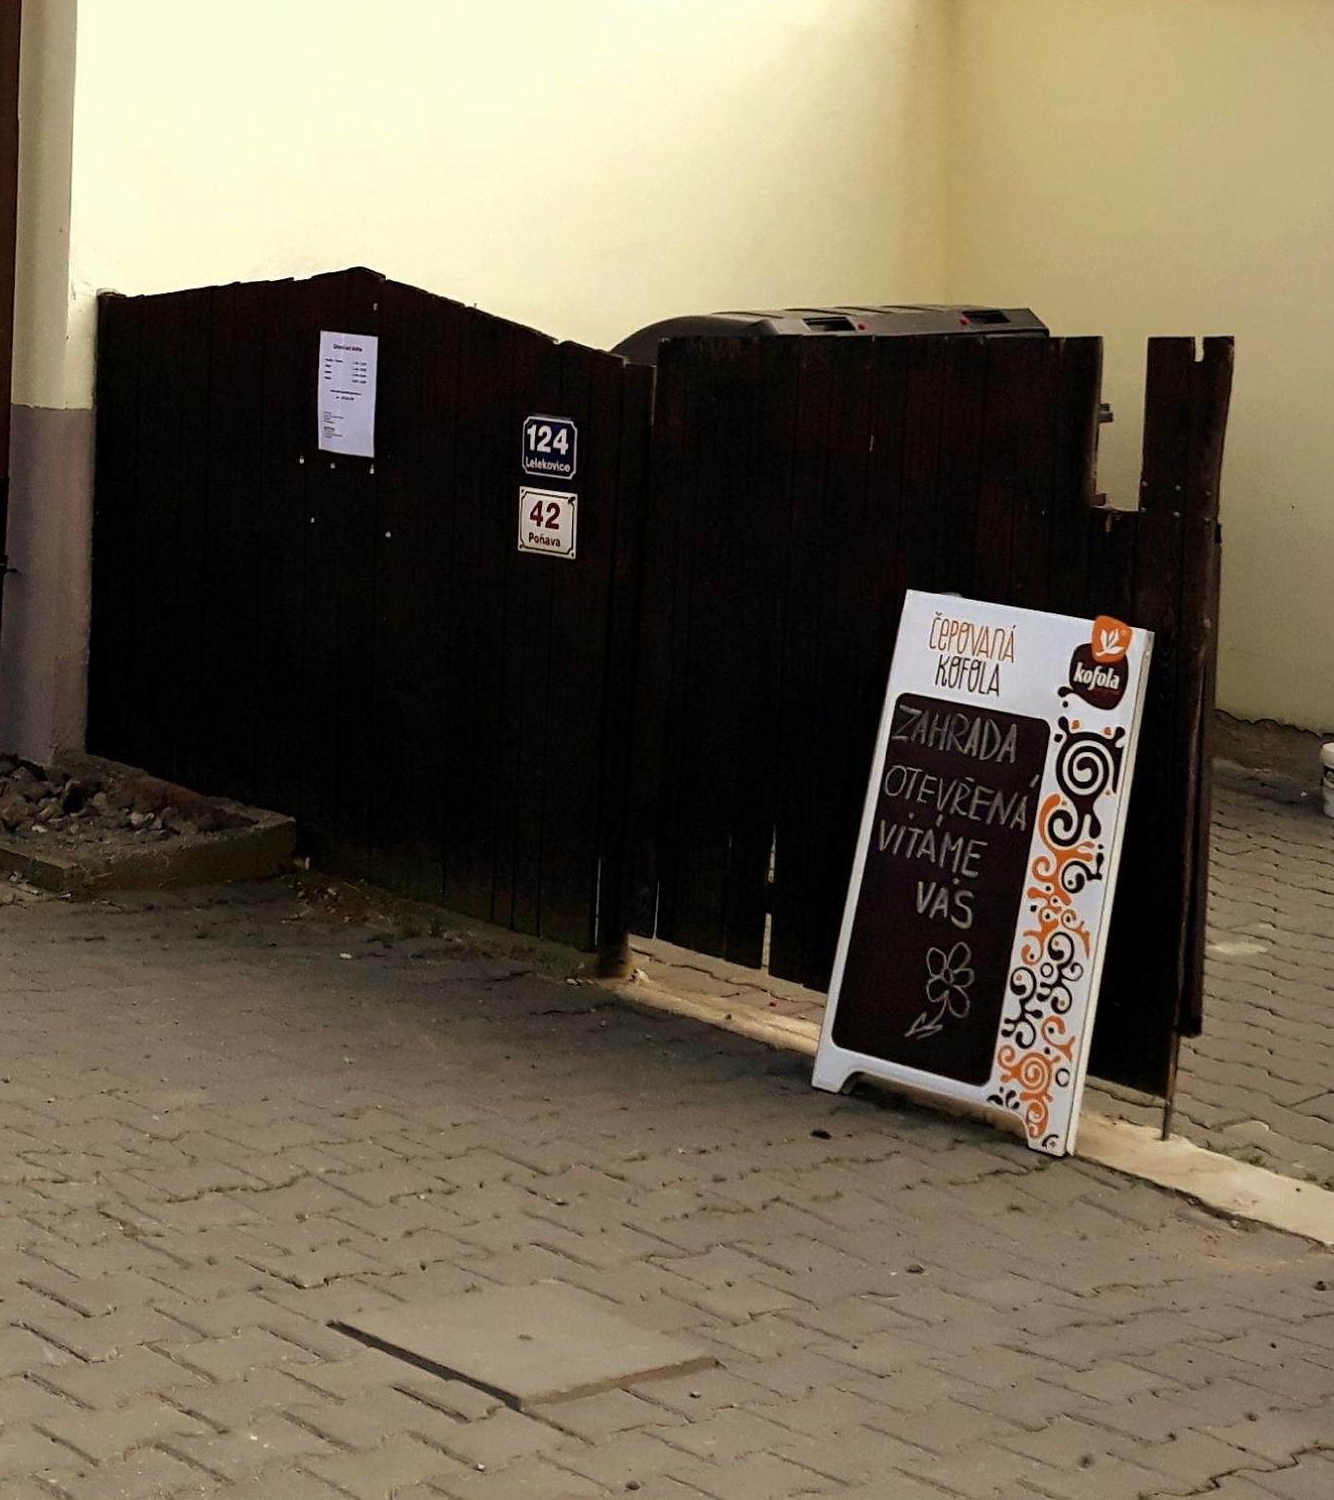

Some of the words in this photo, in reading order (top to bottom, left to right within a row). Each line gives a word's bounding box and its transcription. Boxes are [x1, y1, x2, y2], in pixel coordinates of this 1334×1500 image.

[526, 423, 569, 456] 124
[525, 456, 571, 473] Lelekovice
[529, 500, 561, 530] 42
[934, 654, 1000, 697] KOFOLA
[1073, 661, 1120, 691] kofola
[891, 704, 1018, 764] ZAHRADA
